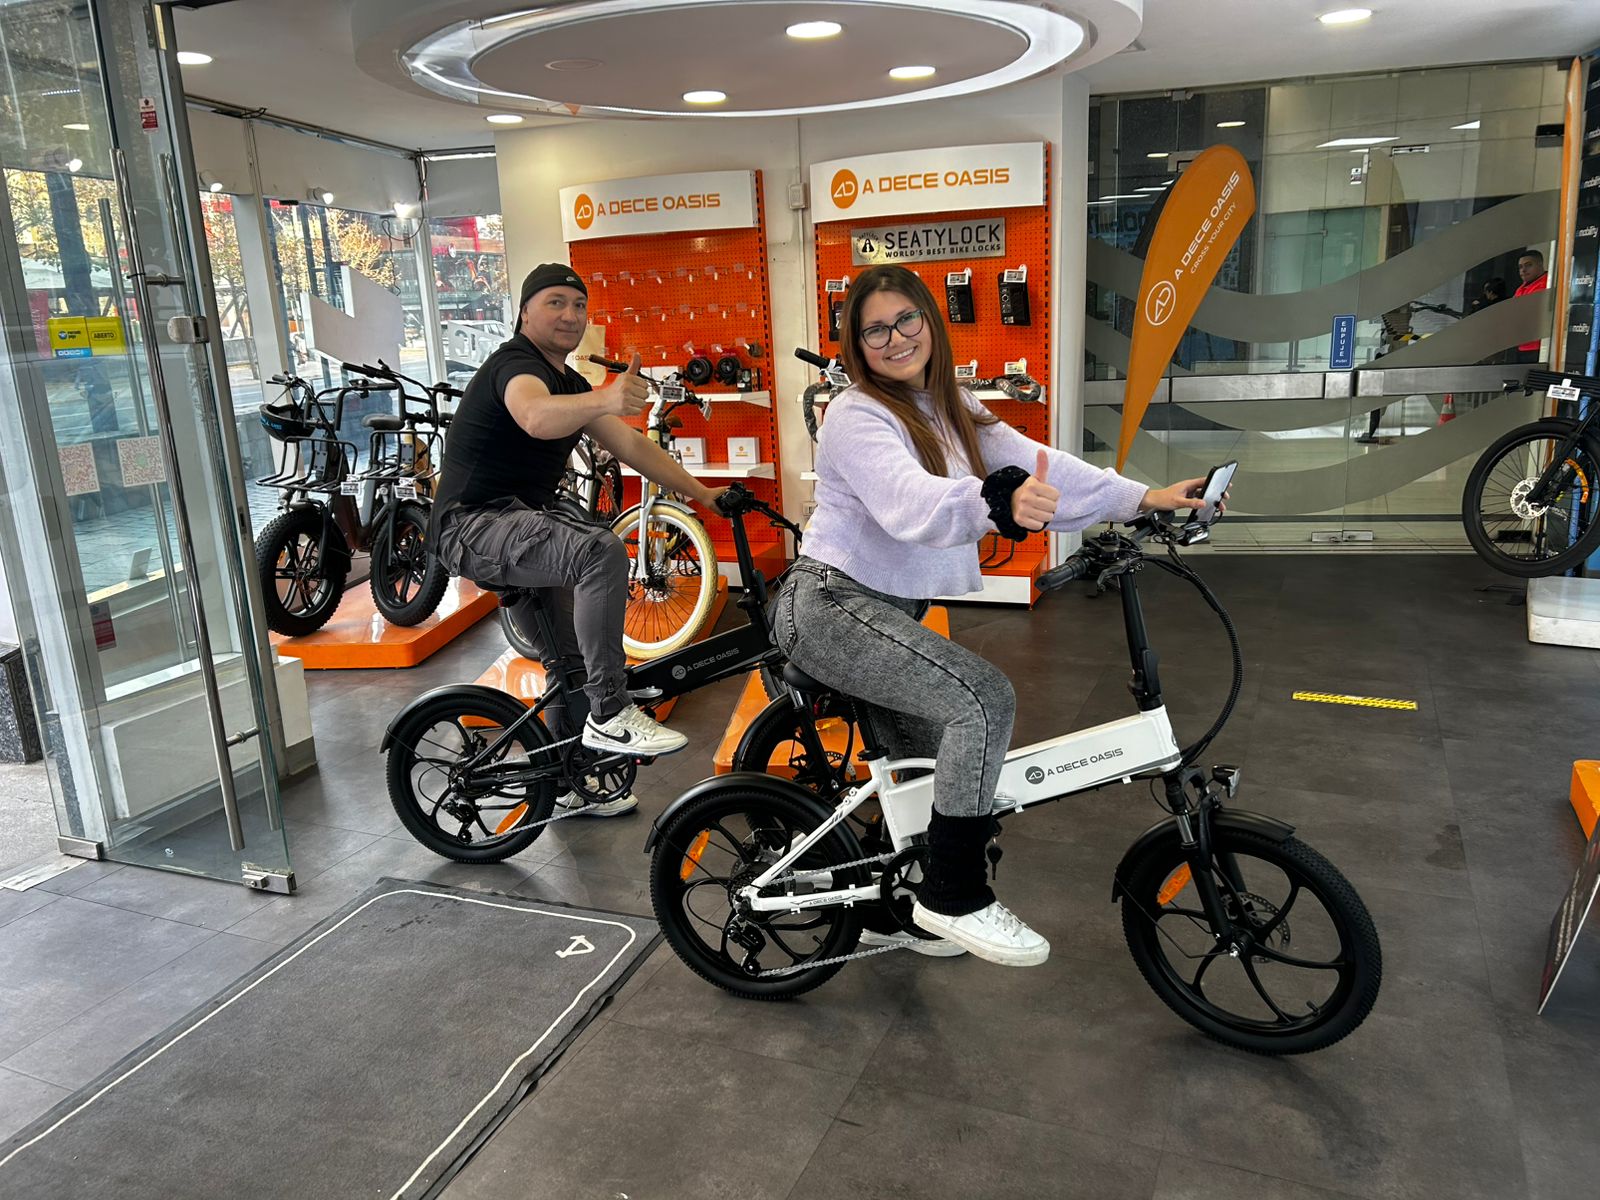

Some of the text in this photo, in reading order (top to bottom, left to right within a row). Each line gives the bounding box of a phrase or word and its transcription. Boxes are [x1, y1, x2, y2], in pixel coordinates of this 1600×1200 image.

[862, 178, 875, 195] A
[878, 172, 939, 193] DECE
[943, 167, 1010, 187] OASIS
[597, 202, 607, 217] A
[609, 197, 658, 215] DECE
[662, 193, 721, 210] OASIS
[884, 223, 1001, 250] SEATYLOCK
[1174, 268, 1184, 281] A
[1180, 218, 1212, 267] DECE
[1210, 170, 1241, 219] OASIS
[1190, 201, 1238, 275] CROSS YOUR CITY
[885, 249, 923, 258] WORLD'S
[926, 247, 947, 255] BEST
[950, 245, 969, 254] BIKE
[972, 243, 1001, 252] LOCKS
[1339, 320, 1347, 357] EMPUJE
[692, 656, 716, 670] DECE
[715, 647, 740, 661] OASIS
[1047, 768, 1055, 776] A
[1056, 758, 1089, 774] DECE
[1089, 747, 1124, 764] OASIS
